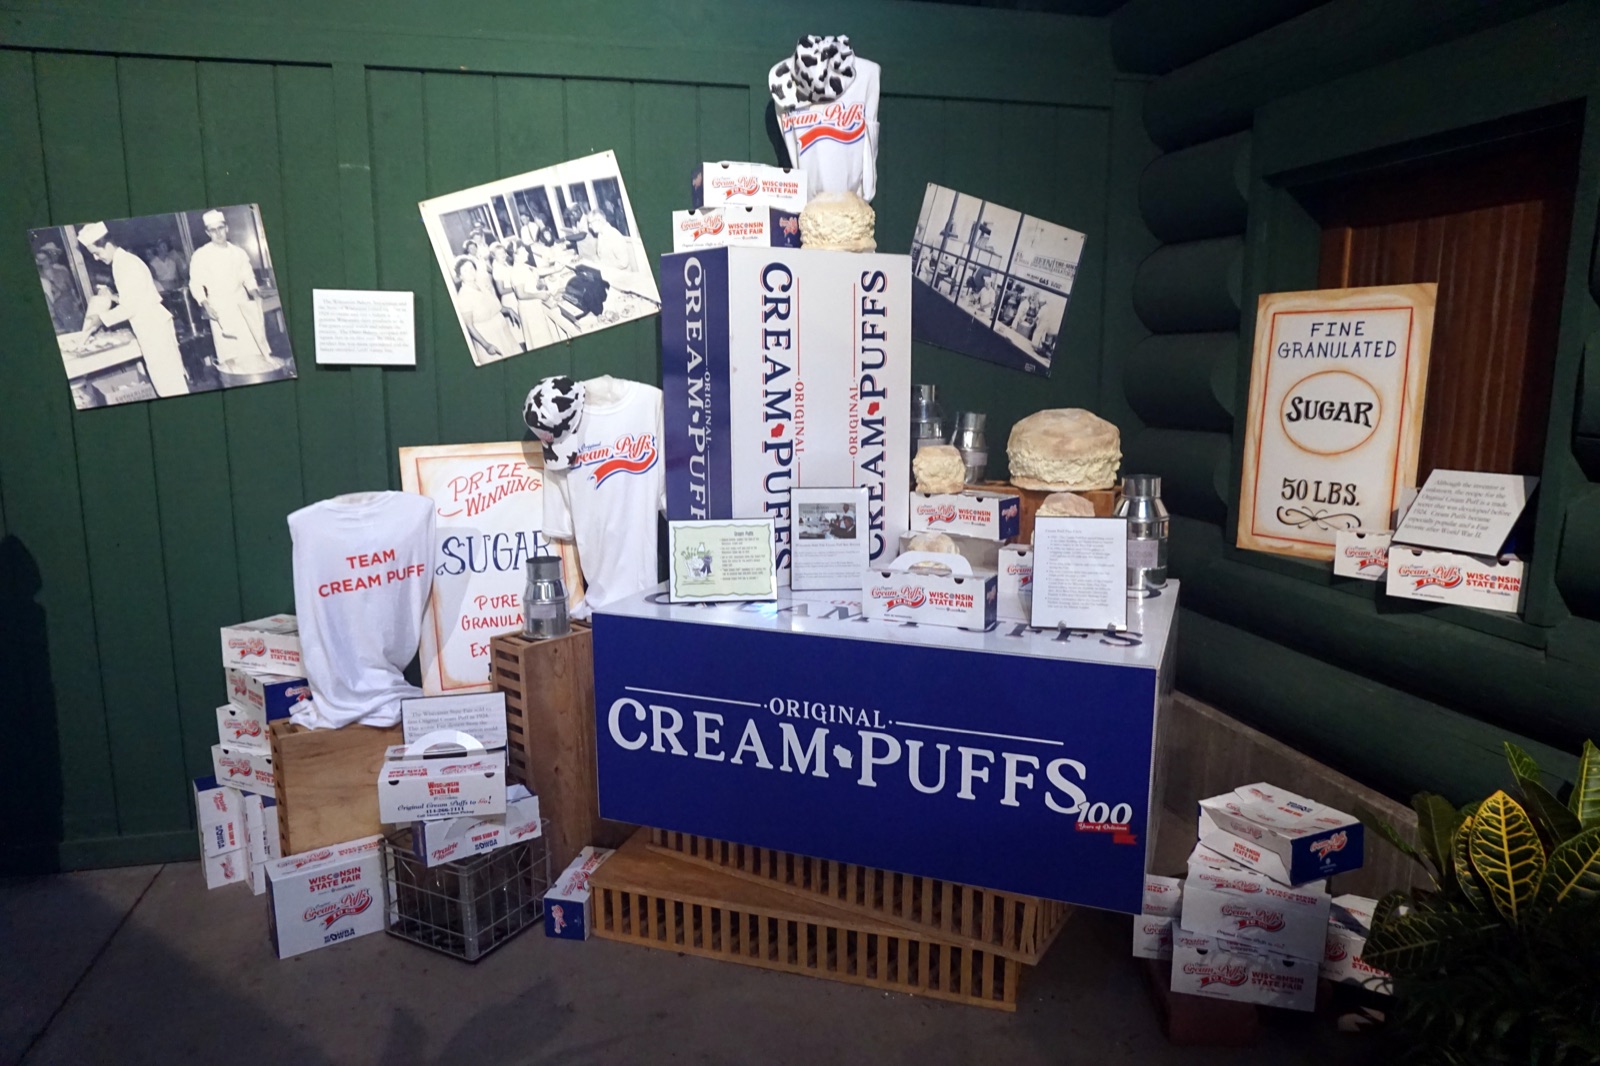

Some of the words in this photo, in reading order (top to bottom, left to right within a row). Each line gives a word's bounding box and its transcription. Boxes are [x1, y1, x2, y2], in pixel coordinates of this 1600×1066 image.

[825, 102, 863, 127] Puffs
[762, 180, 799, 188] WISCONSIN
[684, 257, 704, 409] CREAM
[860, 270, 887, 400] PUFFS
[1311, 321, 1366, 337] FINE
[760, 262, 793, 424] CREAM
[1277, 340, 1397, 359] GRANULATED
[704, 371, 712, 444] ORIGINAL
[1286, 396, 1374, 428] SUGAR
[794, 381, 805, 457] ORIGINAL
[849, 386, 859, 456] ORIGINAL
[616, 434, 651, 458] Puffs
[688, 425, 706, 520] PUFF
[448, 462, 526, 502] PRIZE
[465, 476, 542, 517] WINNING
[1281, 478, 1308, 501] 50
[1313, 480, 1361, 506] LBS.
[959, 508, 991, 516] WISCONSIN
[978, 515, 991, 523] FAIR
[346, 549, 396, 569] TEAM
[435, 530, 550, 576] SUGAR
[1345, 547, 1371, 557] Cream
[318, 574, 381, 598] CREAM
[387, 564, 424, 584] PUFF
[1398, 565, 1428, 577] Cream
[1433, 565, 1458, 579] Puffs
[1466, 572, 1521, 585] WISCONSIN
[871, 587, 897, 598] Cream
[900, 586, 922, 600] Puffs
[1466, 580, 1495, 589] STATE
[1497, 582, 1520, 592] FAIR
[474, 594, 520, 610] PURE
[929, 591, 974, 601] WISCONSIN
[929, 599, 953, 607] STATE
[955, 600, 973, 608] FAIR
[461, 613, 524, 631] GRANULA
[470, 642, 491, 658] EX
[769, 697, 886, 729] ORIGINAL
[607, 697, 830, 778] CREAM
[857, 730, 1087, 814] PUFFS
[429, 787, 446, 796] STATE
[398, 803, 424, 811] Original
[449, 799, 468, 807] Puffs
[1078, 801, 1133, 825] 100
[1233, 847, 1247, 858] STATE
[1248, 853, 1260, 862] FAIR
[1234, 842, 1261, 857] WISCONSIN
[308, 867, 361, 885] WISCONSIN
[309, 880, 339, 893] STATE
[341, 874, 361, 885] FAIR
[304, 904, 337, 921] Cream
[341, 891, 367, 907] Puffs
[1222, 904, 1251, 916] Cream
[1256, 907, 1282, 922] Puffs
[1183, 964, 1213, 974] Cream
[1218, 964, 1244, 977] Puffs
[1252, 971, 1304, 984] WISCONSIN
[1252, 979, 1279, 988] STATE
[1281, 982, 1303, 991] FAIR
